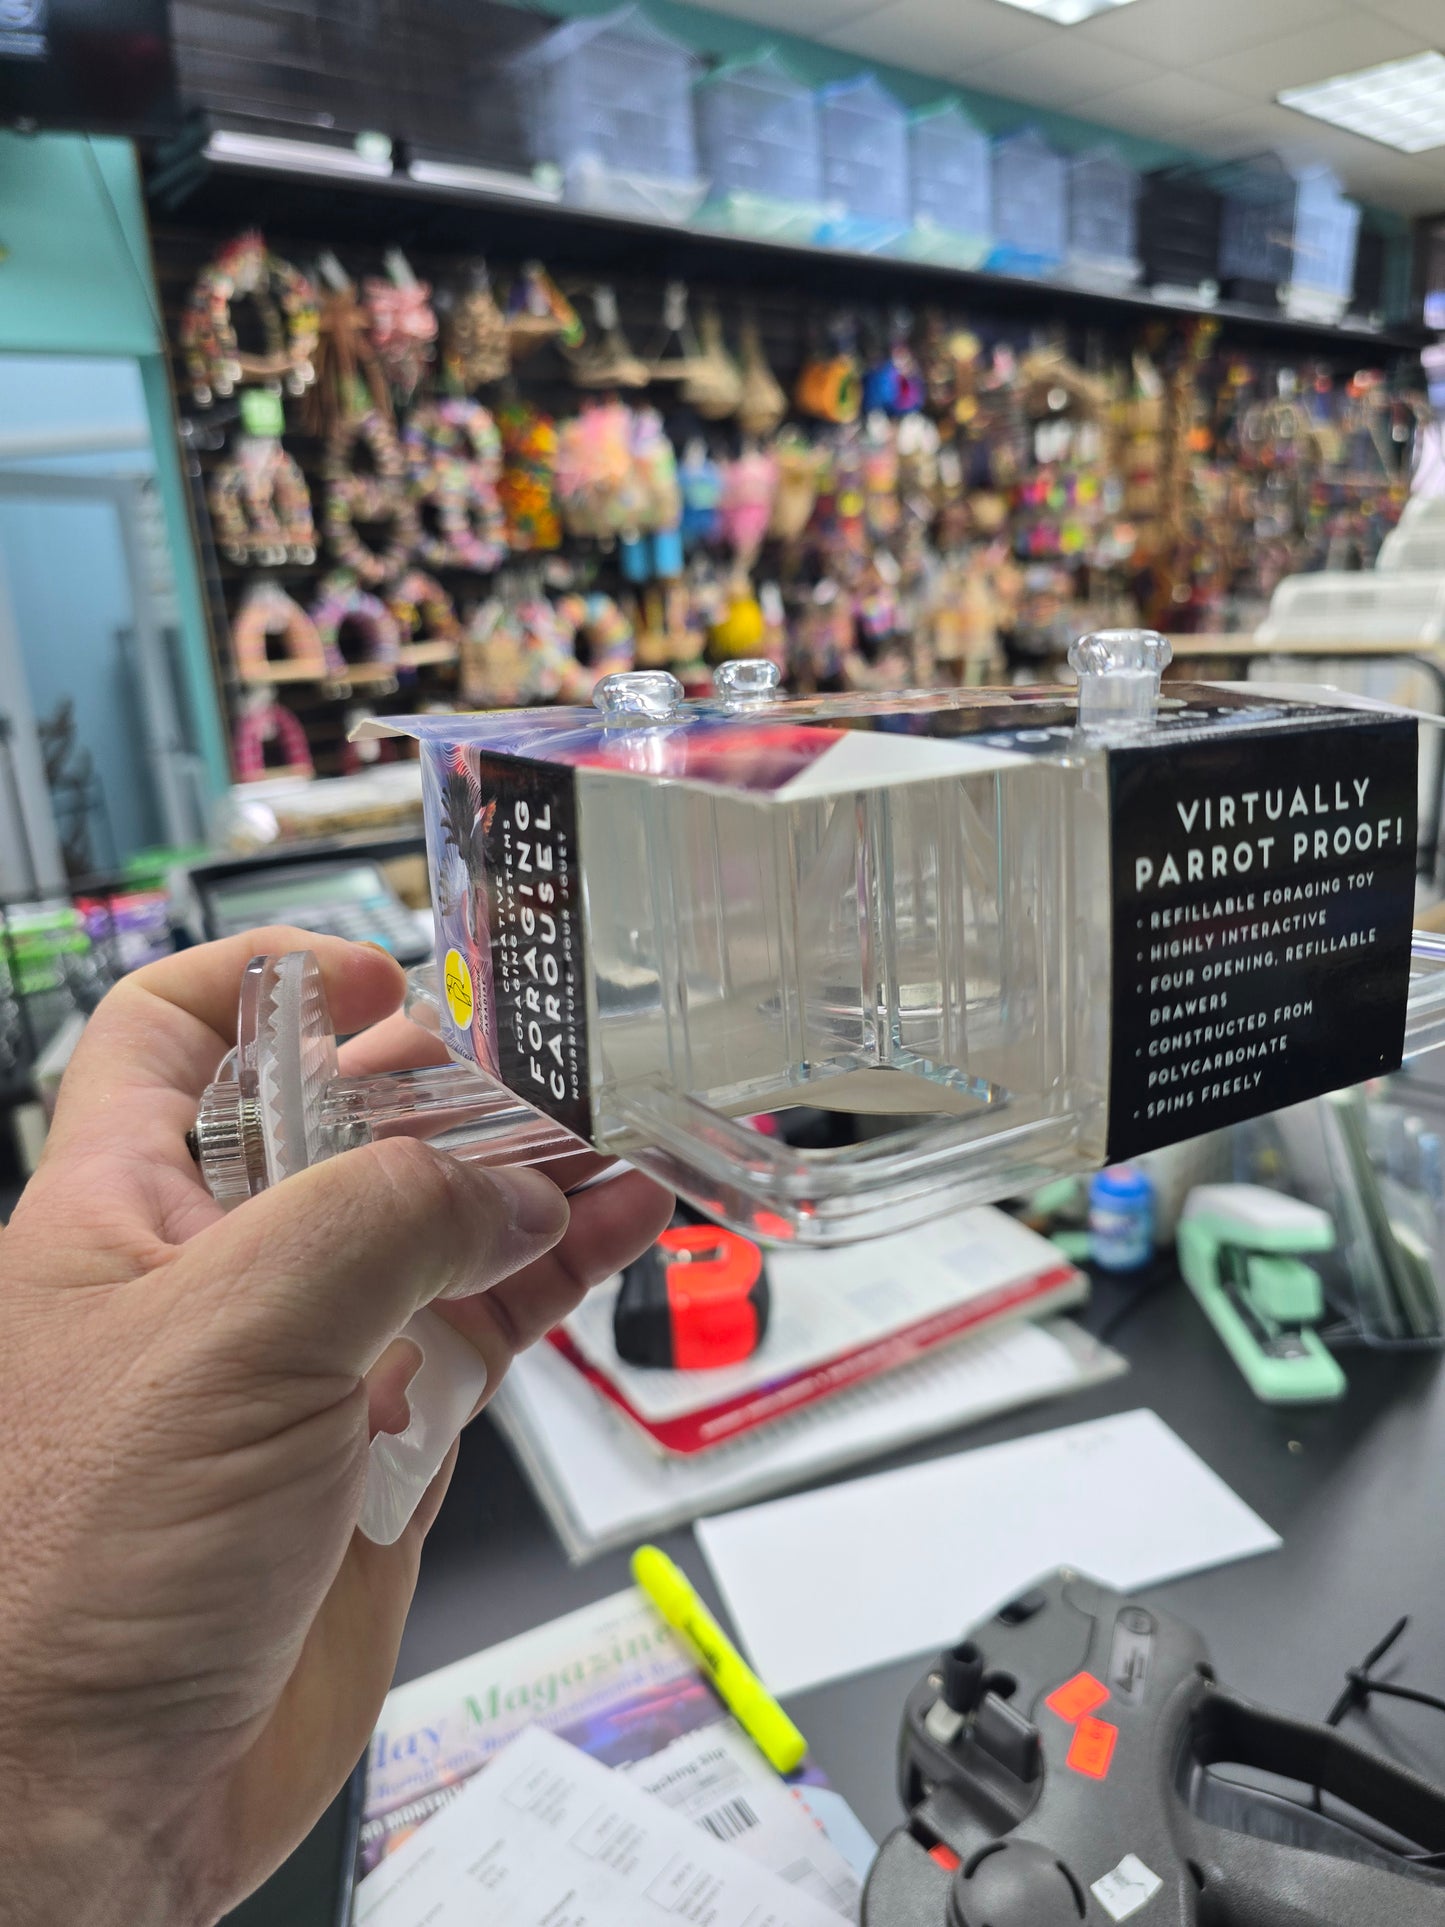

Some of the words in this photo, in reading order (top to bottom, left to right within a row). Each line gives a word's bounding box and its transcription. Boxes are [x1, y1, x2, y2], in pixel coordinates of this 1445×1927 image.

[1177, 778, 1370, 834] VIRTUALLY
[503, 819, 515, 922] SYSTEMS
[558, 832, 569, 899] JOUET
[1135, 837, 1276, 892] PARROT
[1293, 817, 1403, 864] PROOF!
[496, 875, 510, 993] CREATIVE
[1150, 893, 1256, 931] REFILLABLE
[1262, 876, 1341, 907] FORAGING
[1347, 871, 1375, 891] TOY
[515, 800, 545, 1085] FORAGING
[535, 803, 565, 1101] CAROUSEL
[563, 910, 573, 962] POUR
[1150, 931, 1215, 962] HIGHLY
[1221, 909, 1328, 946] INTERACTIVE
[1150, 967, 1196, 995] FOUR
[1285, 928, 1378, 963] REFILLABLE
[510, 934, 524, 1054] FORAGING
[1149, 991, 1229, 1026] DRAWERS
[567, 971, 580, 1100] NOURRITURE
[1147, 1013, 1268, 1057] CONSTRUCTED
[1273, 1000, 1314, 1025] FROM
[1147, 1035, 1289, 1088] POLYCARBONATE
[1146, 1090, 1195, 1119] SPINS
[1200, 1070, 1263, 1103] FREELY
[461, 1622, 674, 1732] Magazine
